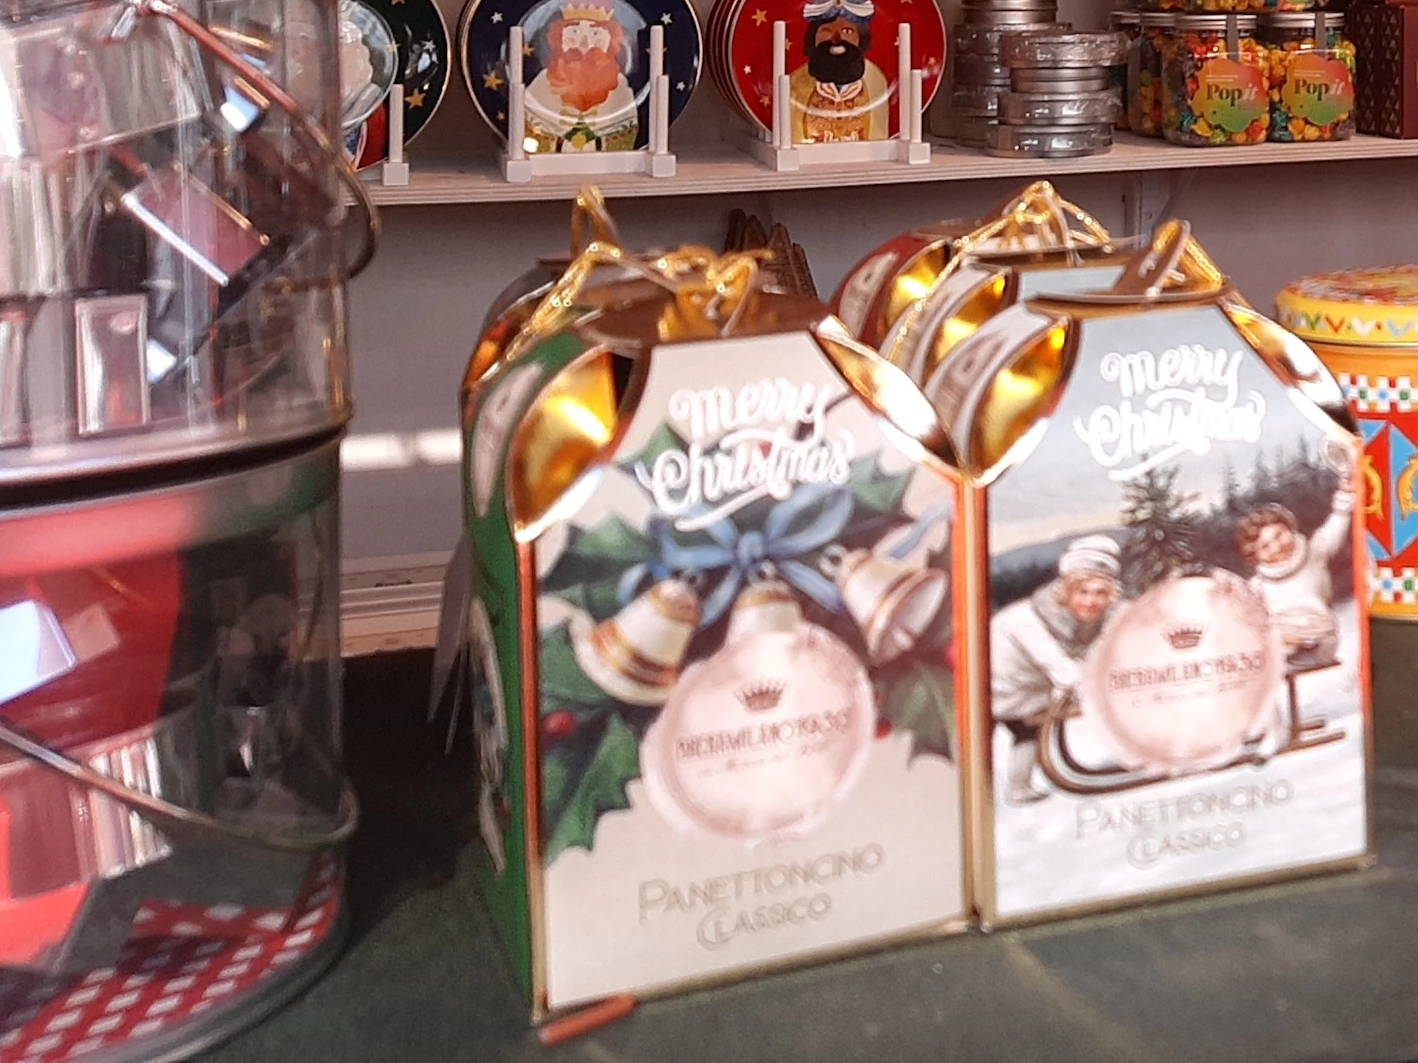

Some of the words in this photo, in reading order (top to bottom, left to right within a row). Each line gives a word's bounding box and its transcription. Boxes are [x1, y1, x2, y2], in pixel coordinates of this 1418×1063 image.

[668, 377, 832, 445] Merry
[1100, 344, 1244, 409] Merry
[1072, 388, 1267, 481] Christmas
[634, 428, 856, 532] Christmas
[637, 843, 885, 926] PANETTONCINO
[696, 893, 833, 951] CLASSICO
